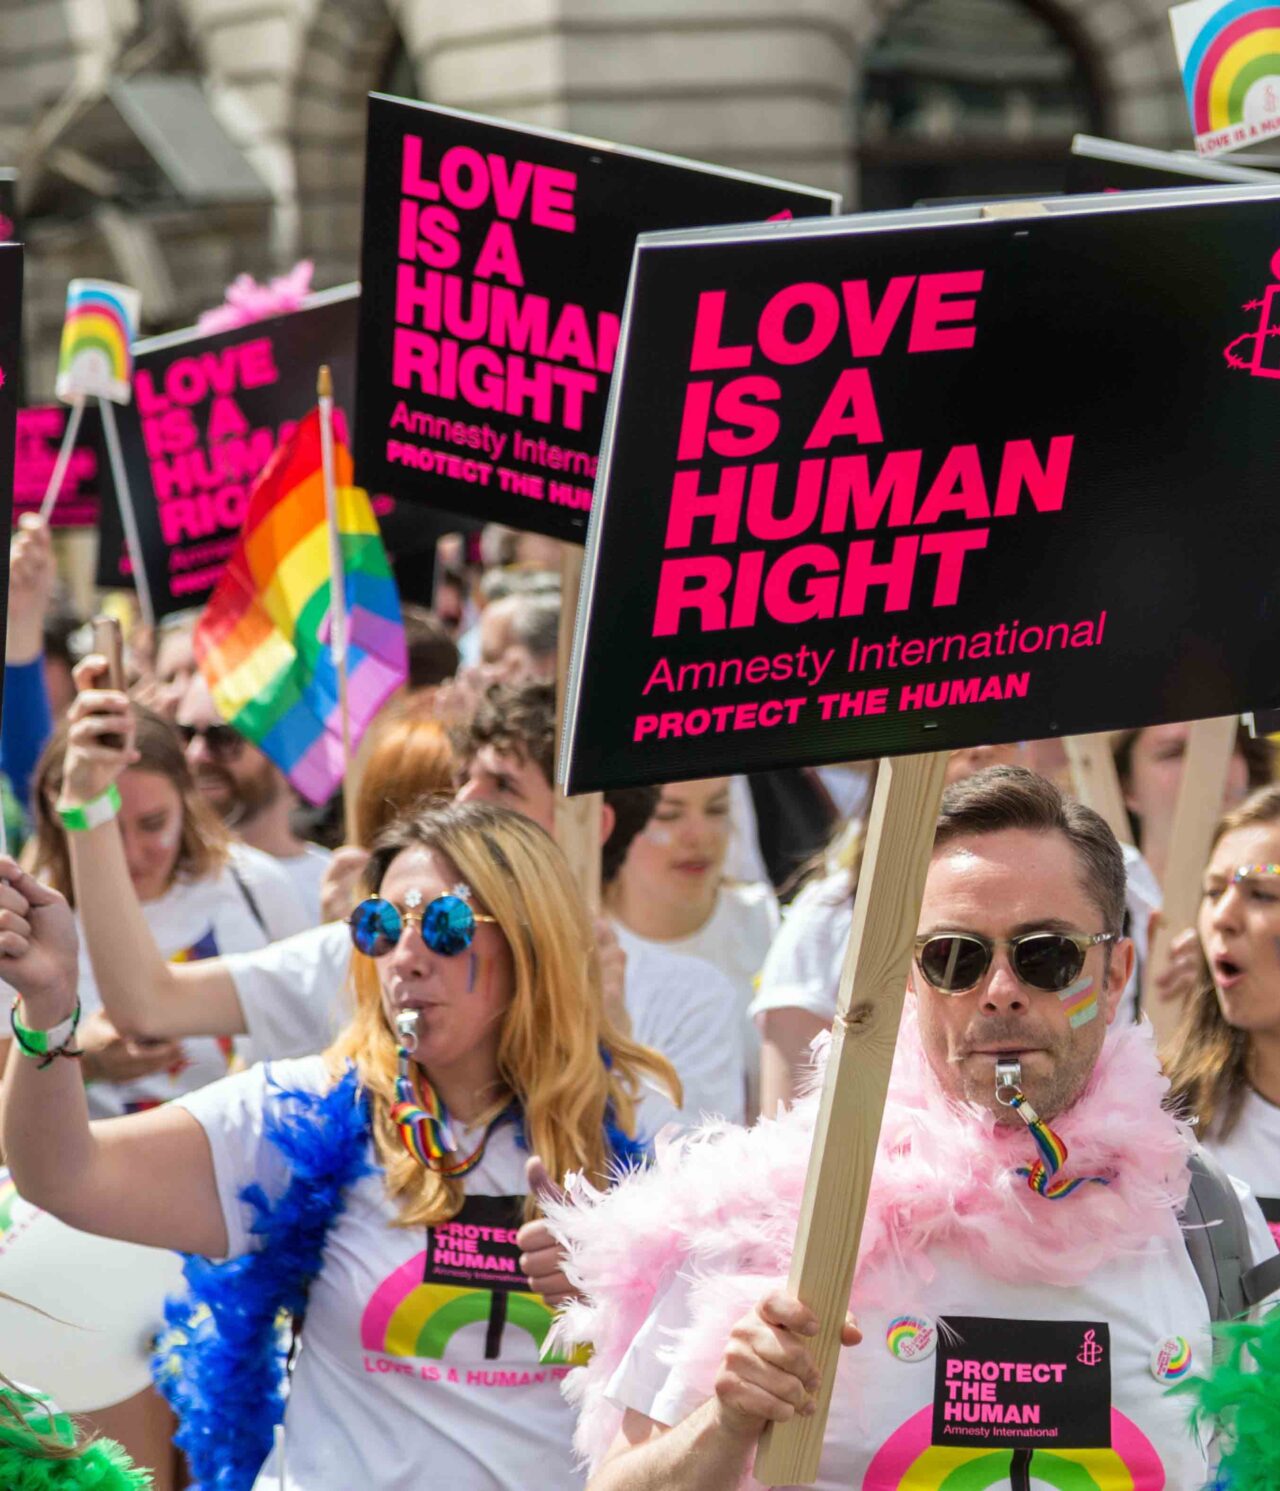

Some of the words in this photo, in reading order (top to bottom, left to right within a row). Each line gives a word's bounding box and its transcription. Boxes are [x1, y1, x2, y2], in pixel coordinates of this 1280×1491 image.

[1199, 136, 1230, 155] LOVE
[402, 134, 577, 233] LOVE
[399, 200, 462, 268] IS
[473, 221, 524, 287] A
[689, 270, 985, 372] LOVE
[135, 338, 279, 411] LOVE
[392, 328, 597, 431] RIGHT
[141, 407, 198, 460] IS
[207, 394, 250, 440] A
[389, 400, 508, 461] Amnesty
[677, 374, 782, 461] IS
[804, 367, 884, 450] A
[386, 438, 493, 486] PROTECT
[496, 466, 544, 500] THE
[663, 435, 1075, 550] HUMAN
[651, 527, 990, 638] RIGHT
[642, 643, 835, 697] Amnesty
[846, 611, 1107, 675] International
[633, 697, 807, 743] PROTECT
[818, 689, 888, 721] THE
[897, 672, 1030, 713] HUMAN
[433, 1250, 516, 1273] HUMAN
[435, 1234, 479, 1253] THE
[421, 1366, 440, 1381] IS
[466, 1368, 545, 1387] HUMAN
[945, 1380, 997, 1402] THE
[946, 1358, 1067, 1384] PROTECT
[943, 1424, 991, 1439] Amnesty
[993, 1425, 1058, 1438] International
[944, 1401, 1040, 1424] HUMAN
